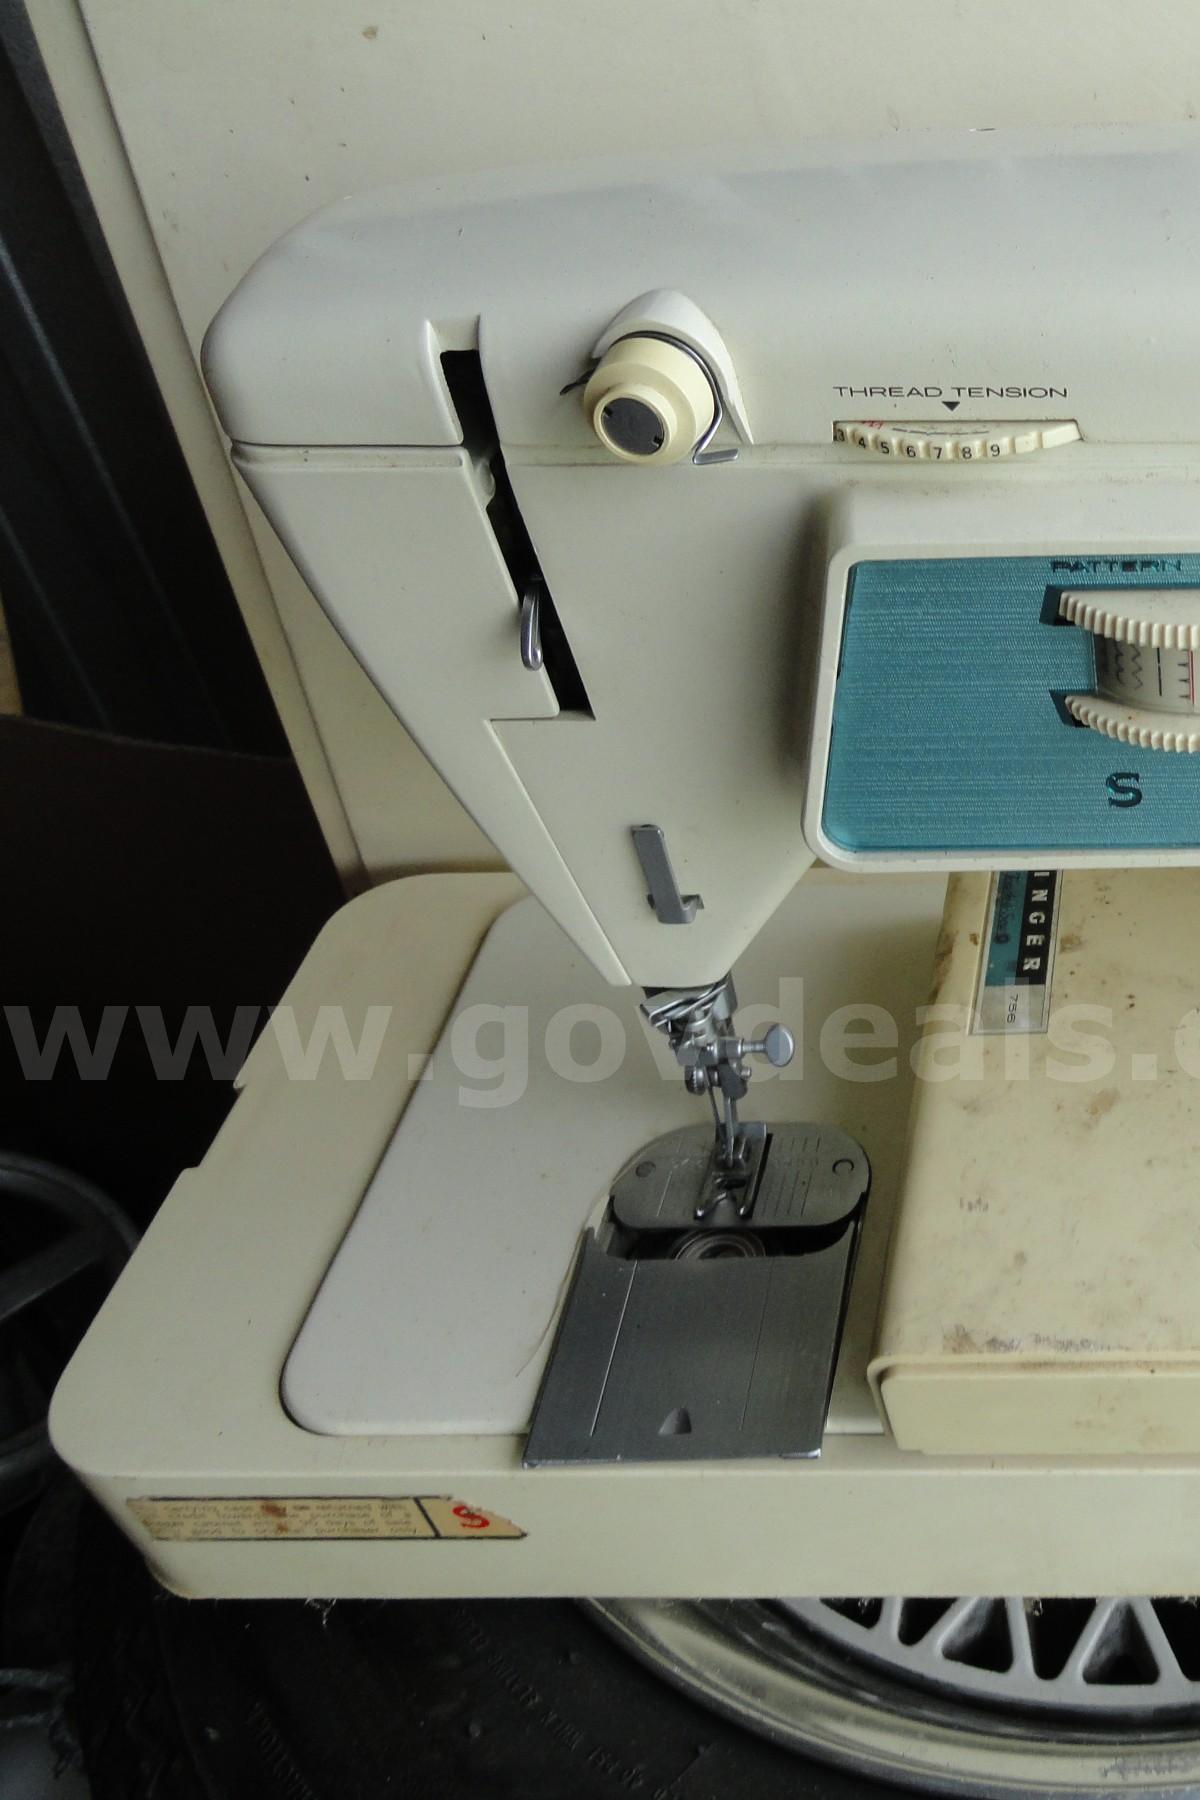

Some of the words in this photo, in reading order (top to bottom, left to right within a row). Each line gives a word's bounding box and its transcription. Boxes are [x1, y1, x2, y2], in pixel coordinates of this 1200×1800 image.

[833, 386, 943, 398] THREAD
[950, 386, 1068, 398] TENSION
[857, 437, 867, 449] 4
[880, 441, 891, 454] 5
[906, 445, 917, 458] 6
[933, 447, 943, 459] 7
[962, 447, 973, 459] 8
[990, 444, 1001, 457] 9
[1050, 559, 1182, 574] PATTERN
